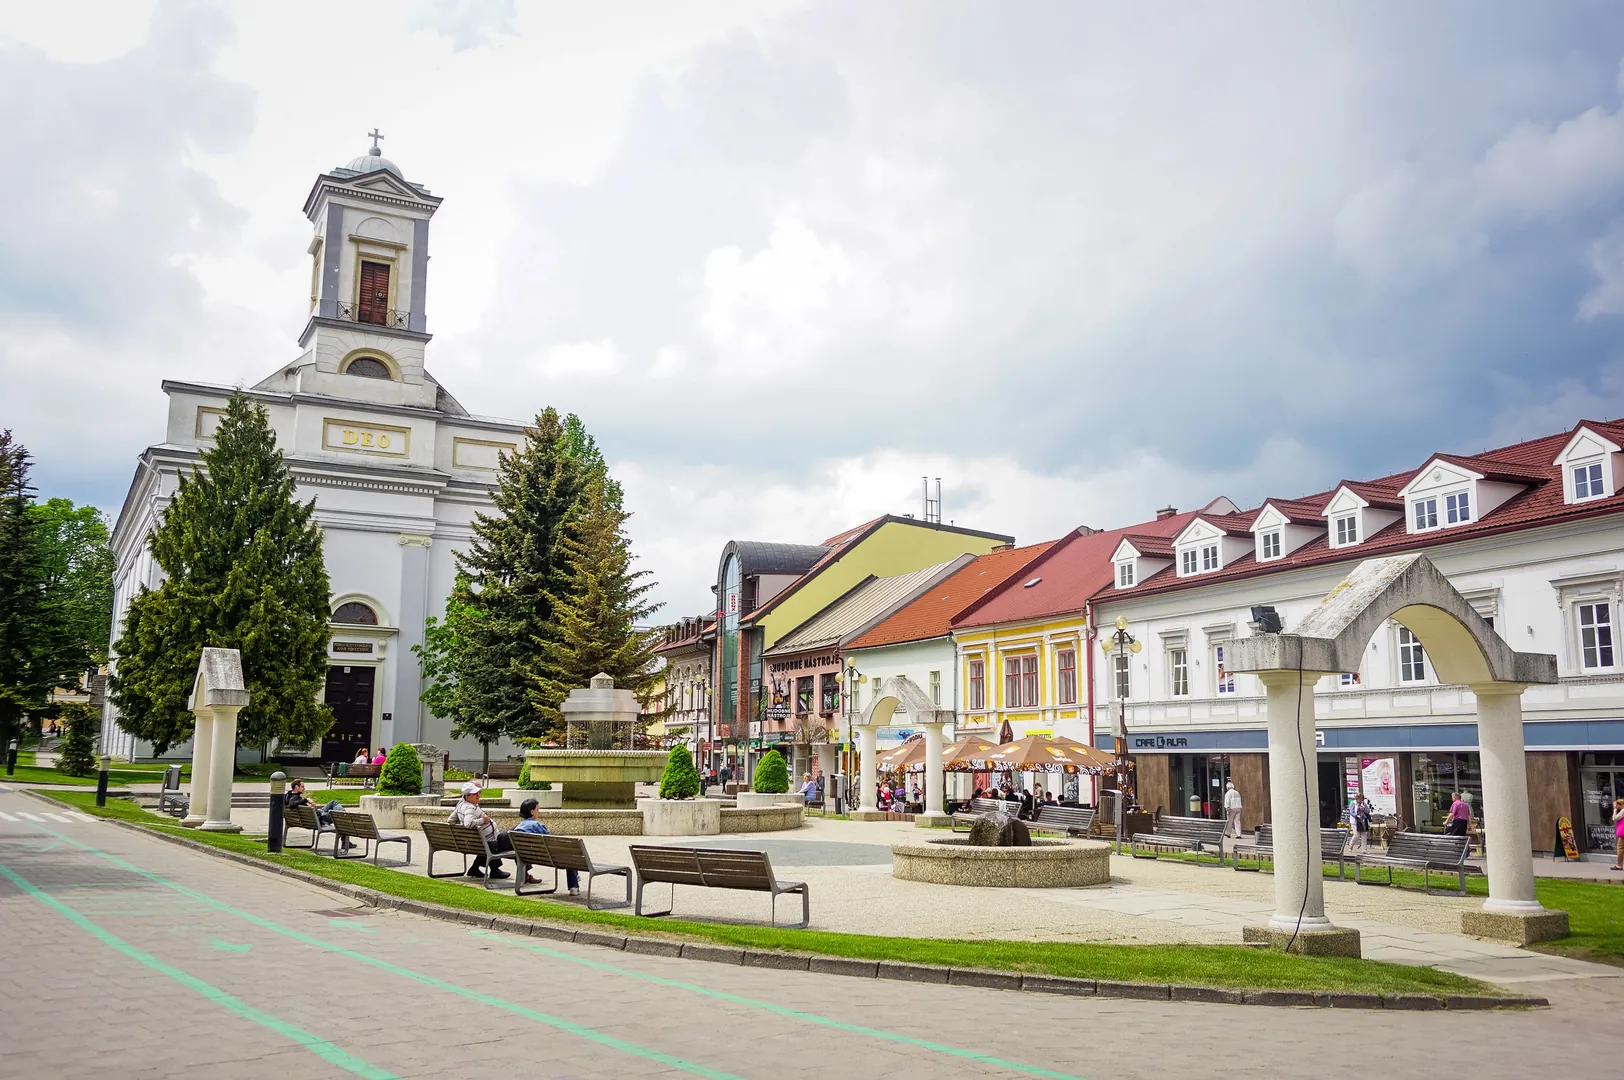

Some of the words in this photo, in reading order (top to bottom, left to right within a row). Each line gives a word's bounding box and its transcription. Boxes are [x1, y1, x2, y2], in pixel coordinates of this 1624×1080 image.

[342, 429, 391, 449] DEO
[772, 658, 803, 673] HUDOBNÉ
[804, 654, 840, 669] NÁSTROJE
[1135, 738, 1155, 747] CAFE
[1166, 737, 1188, 747] ALFA
